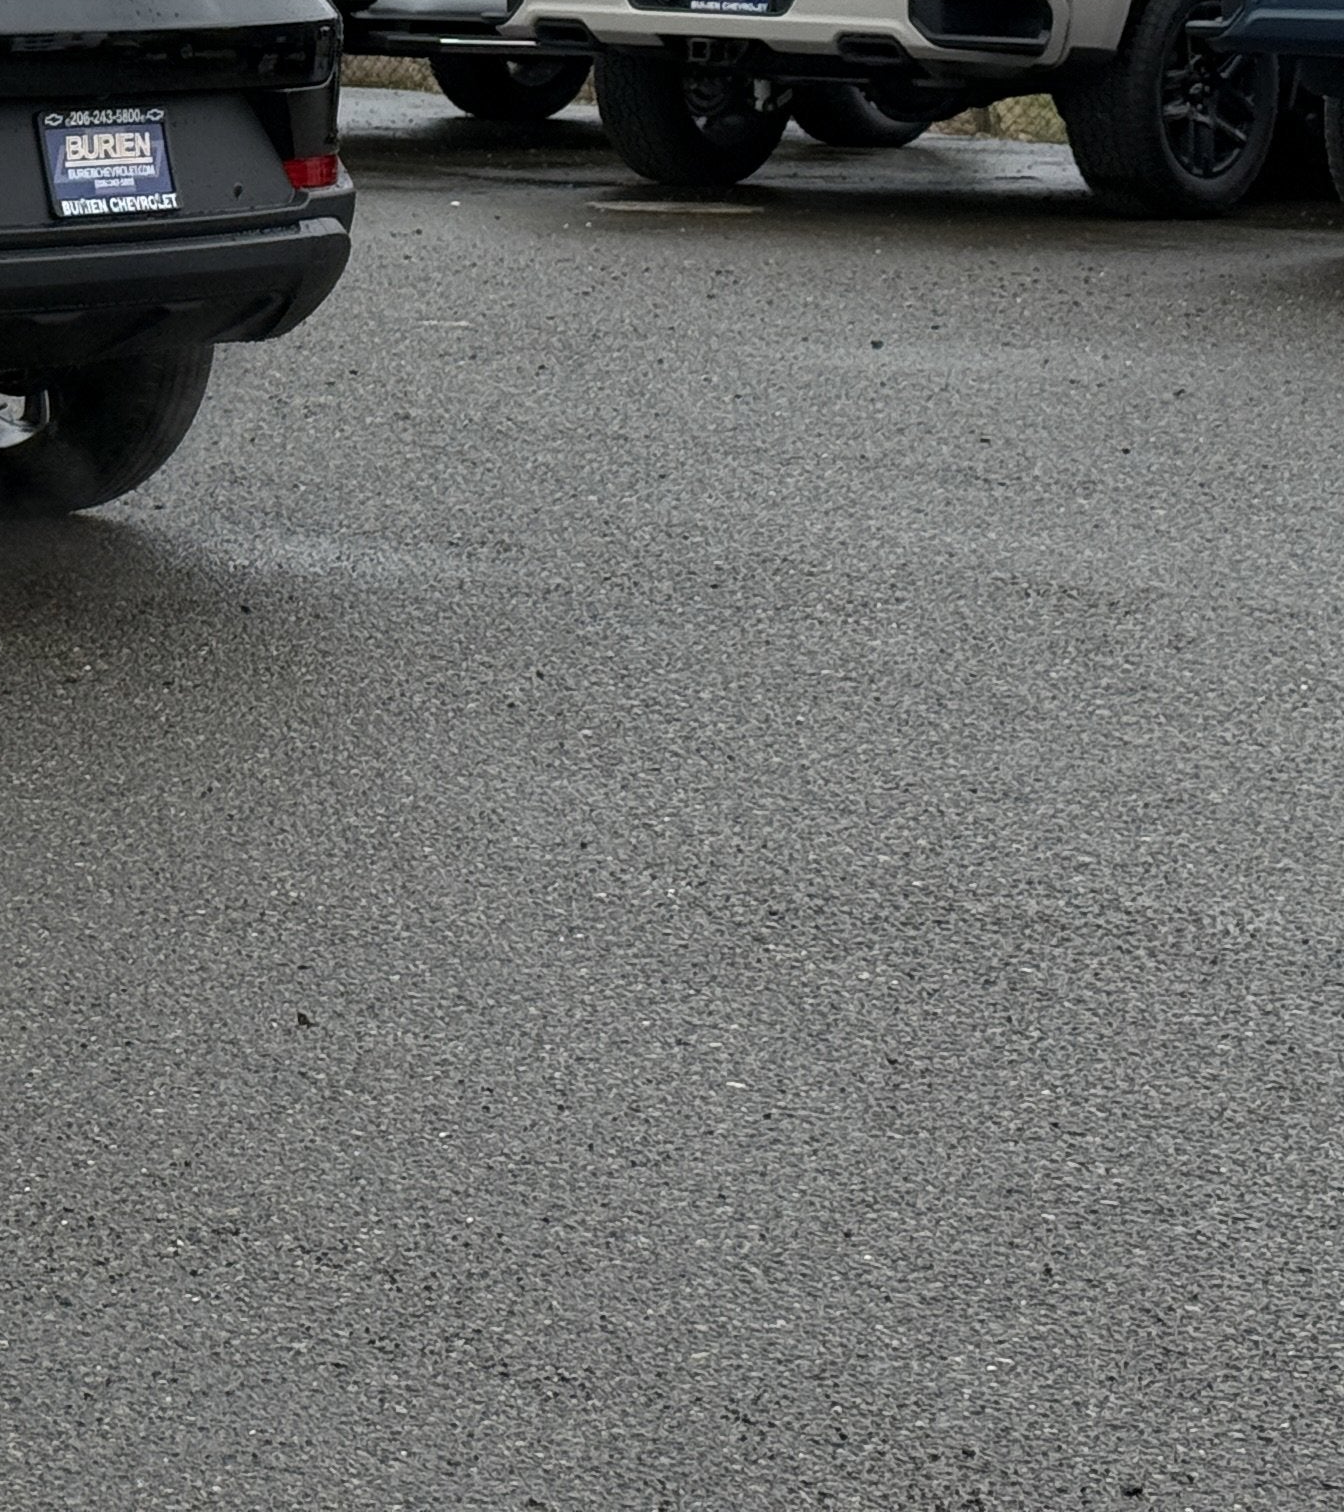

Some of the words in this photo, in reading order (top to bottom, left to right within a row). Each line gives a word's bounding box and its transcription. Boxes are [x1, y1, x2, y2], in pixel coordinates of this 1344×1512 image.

[70, 108, 141, 126] 206-243-5800
[65, 131, 152, 161] BURIEN
[109, 192, 179, 213] CHEVROLET
